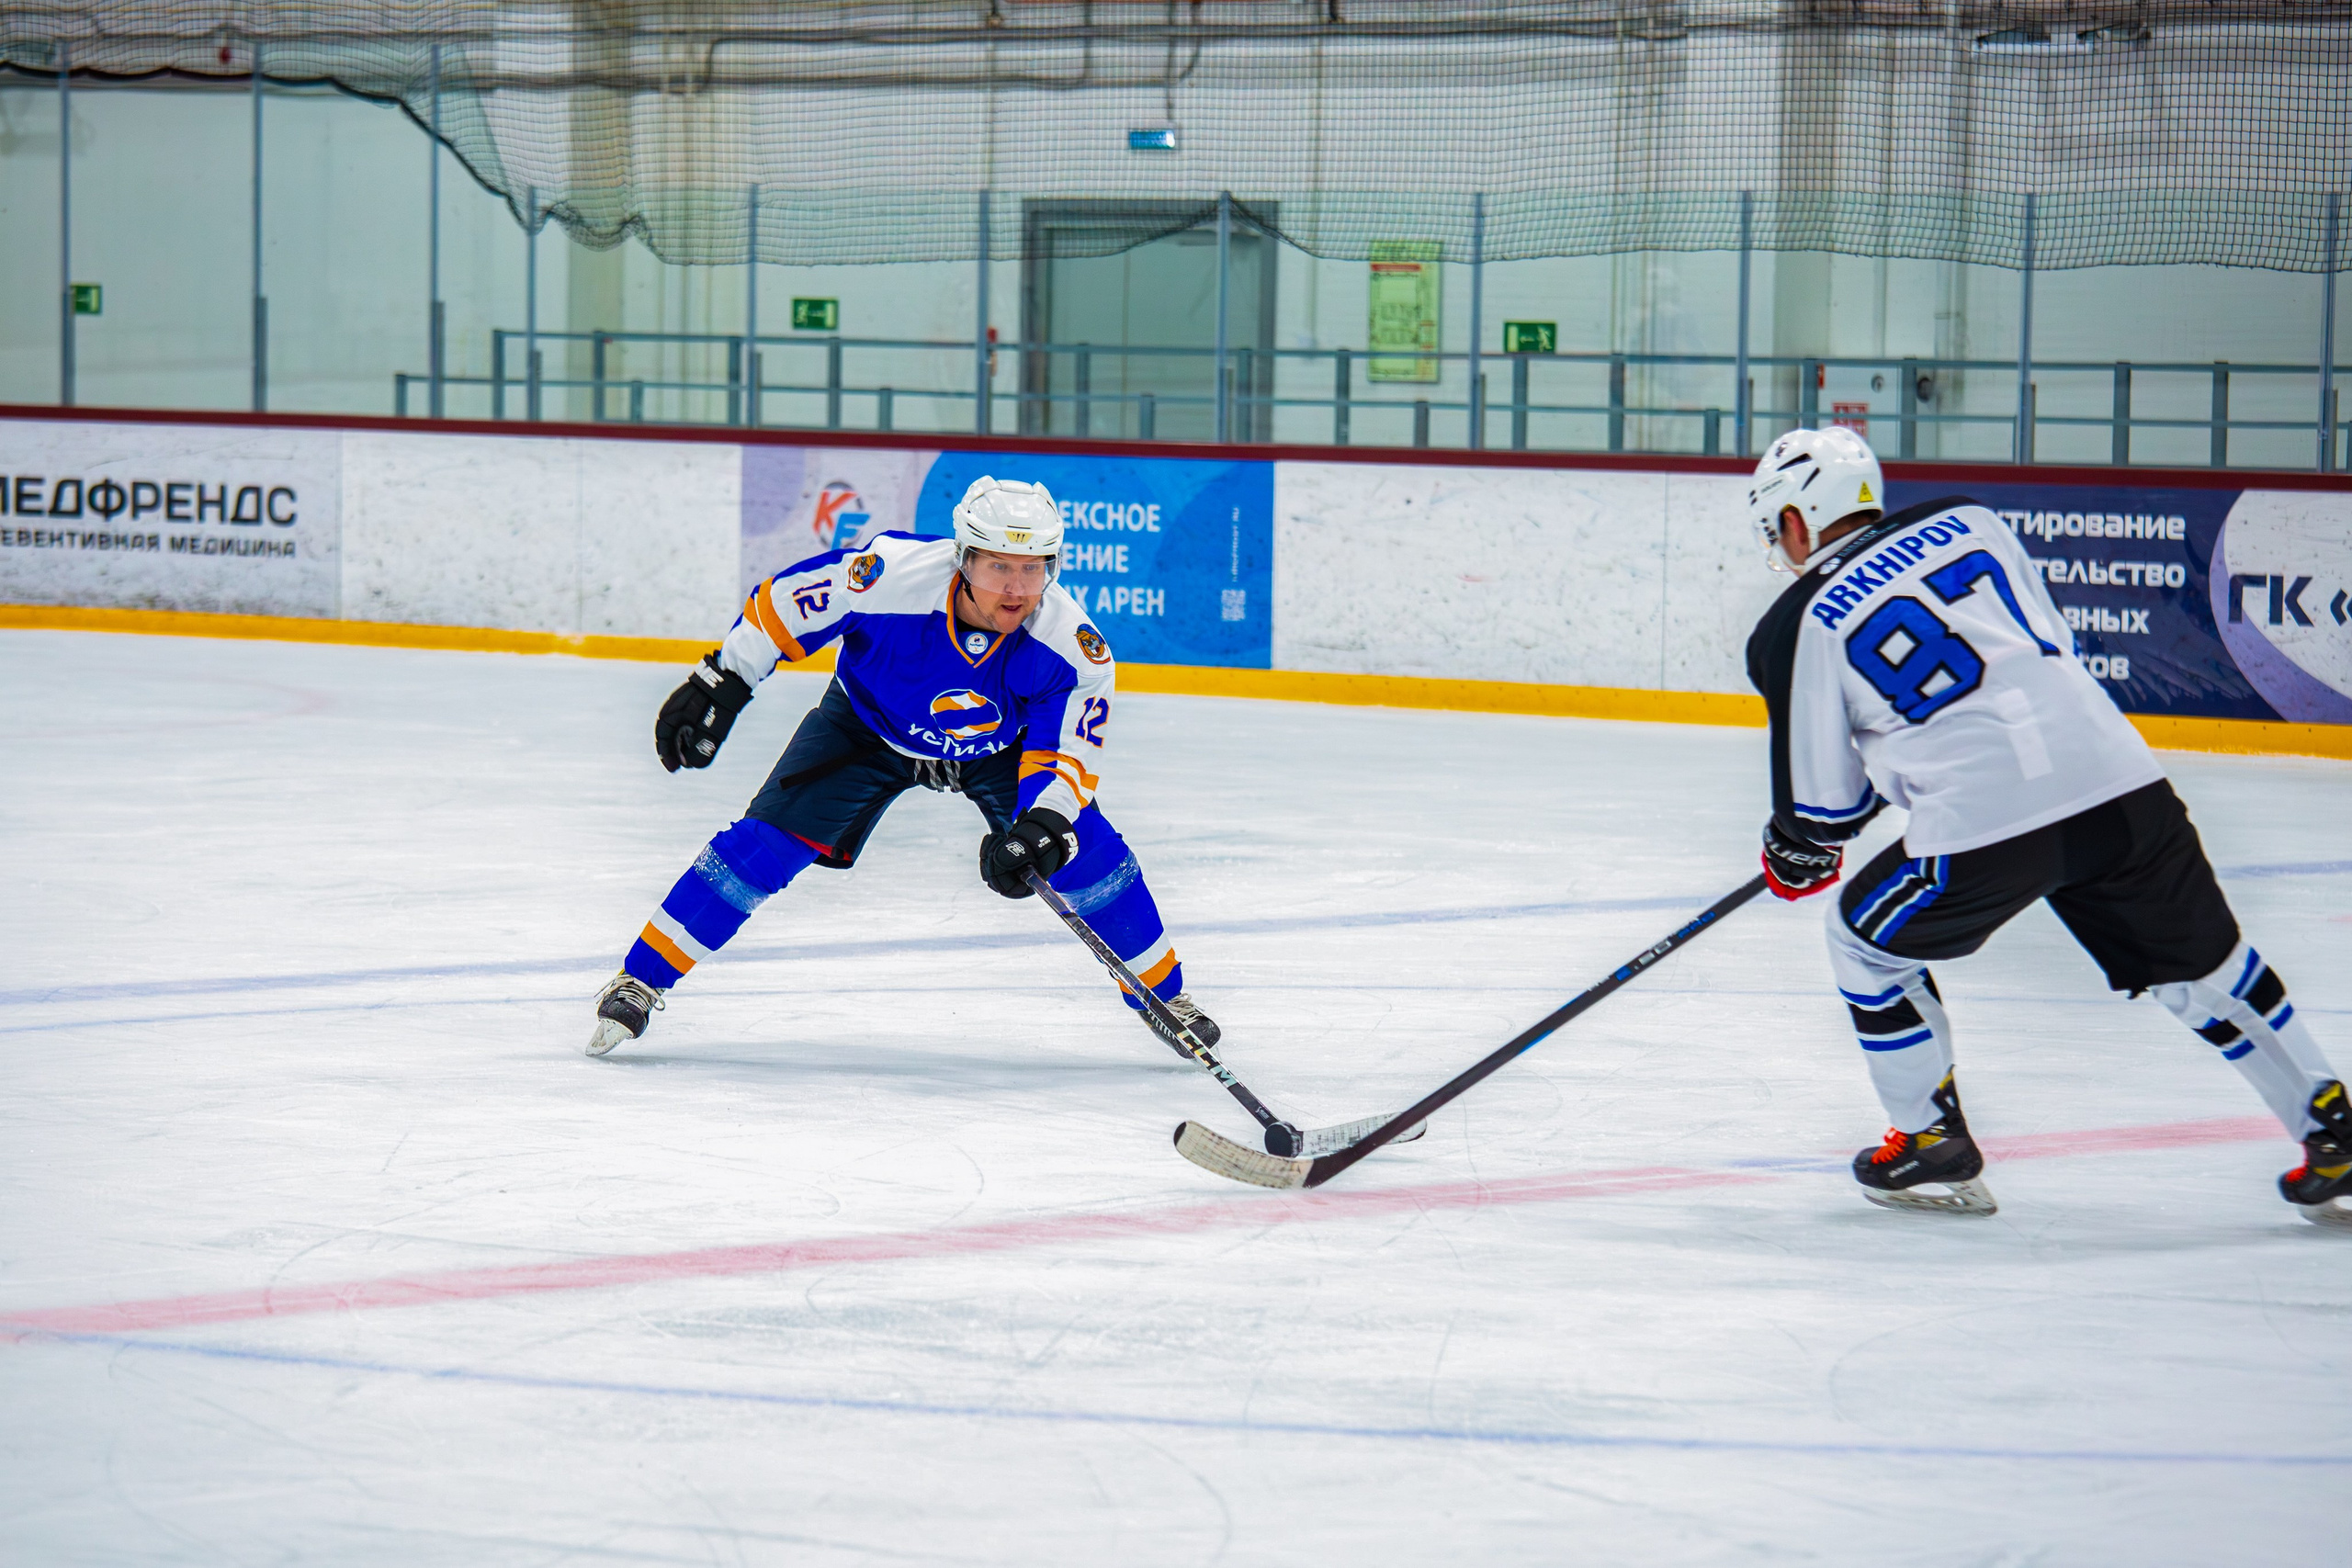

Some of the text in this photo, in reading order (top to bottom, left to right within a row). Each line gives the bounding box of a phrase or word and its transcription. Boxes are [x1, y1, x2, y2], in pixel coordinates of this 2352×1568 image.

[170, 536, 296, 559] МЕДИЦИНА
[1996, 510, 2186, 543] тирование
[1811, 514, 1973, 631] ARKHIPOV
[792, 579, 831, 620] 12
[1095, 585, 1165, 617] АРЕН
[2228, 572, 2314, 628] ГК
[1845, 548, 2062, 725] 87
[2082, 652, 2131, 681] ов
[1075, 696, 1111, 749] 12
[1176, 1028, 1238, 1089] CCM
